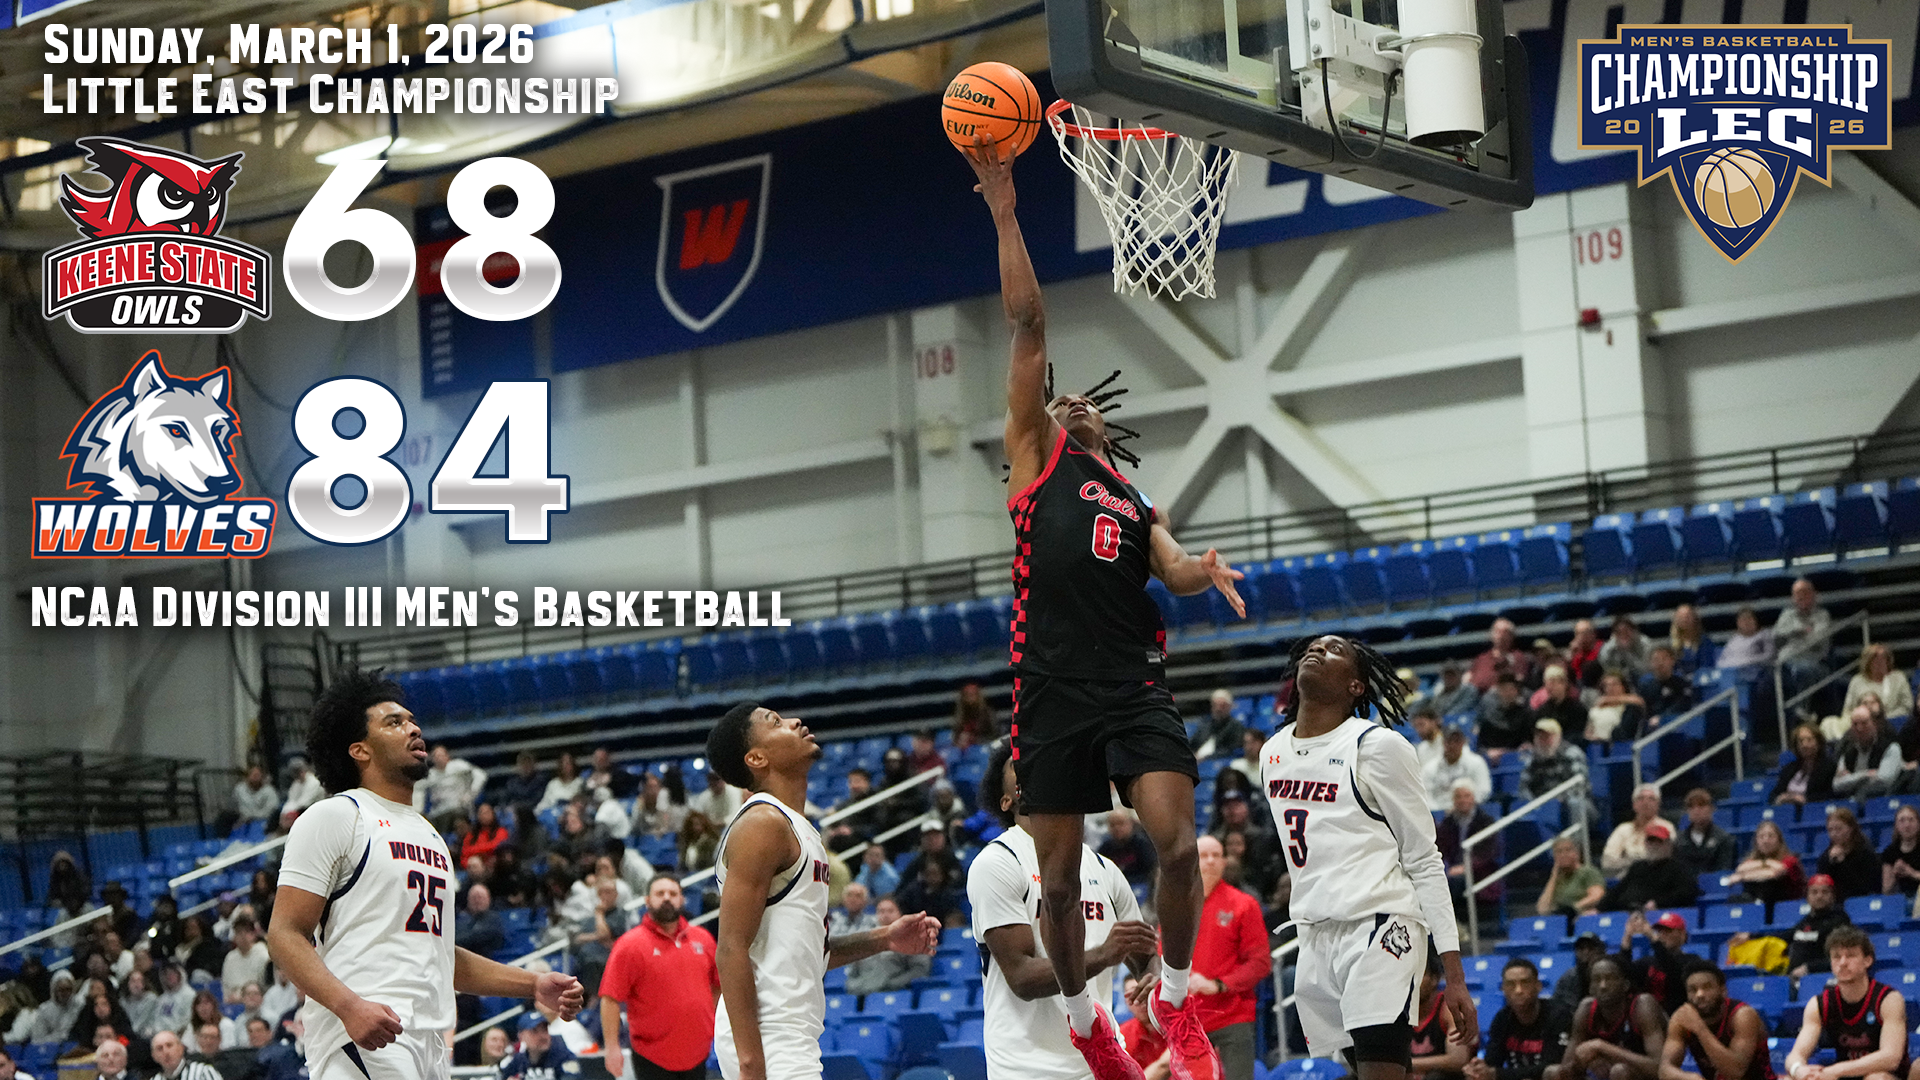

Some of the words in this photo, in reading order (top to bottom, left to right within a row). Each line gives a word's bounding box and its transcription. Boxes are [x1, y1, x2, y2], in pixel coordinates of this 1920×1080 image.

[945, 82, 997, 110] Wilson
[680, 199, 750, 270] W
[1576, 227, 1623, 266] 109
[915, 345, 955, 379] 108
[1079, 480, 1140, 522] Owls
[1092, 513, 1122, 562] 0
[1269, 779, 1338, 803] WOLVES
[388, 841, 449, 872] WOLVES
[1284, 808, 1309, 868] 3
[405, 869, 446, 937] 25
